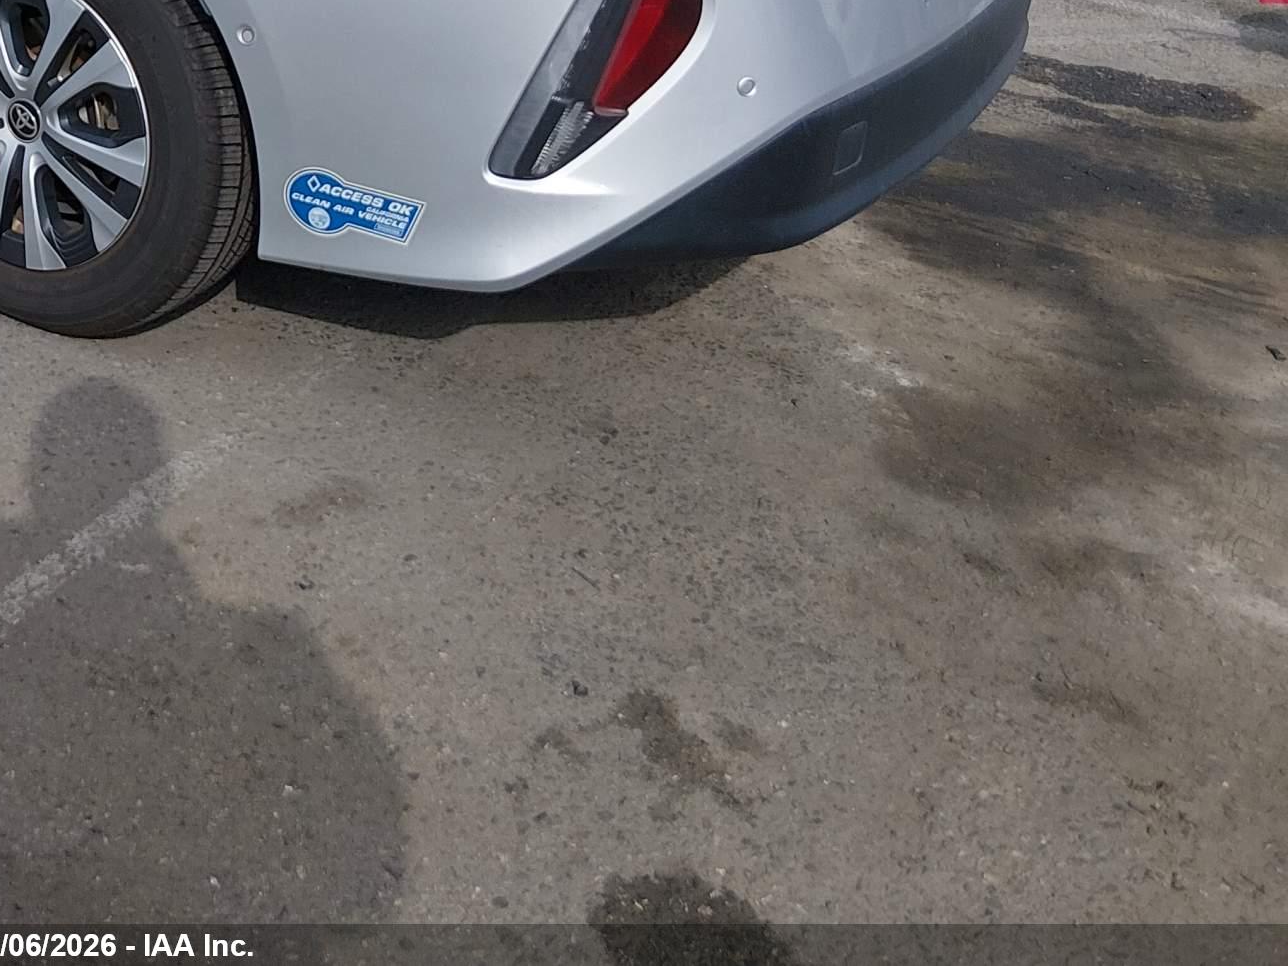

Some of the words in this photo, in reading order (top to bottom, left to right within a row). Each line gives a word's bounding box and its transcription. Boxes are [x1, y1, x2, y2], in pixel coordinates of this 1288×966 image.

[291, 192, 331, 209] CLEAN
[332, 204, 355, 216] AIR
[358, 210, 408, 229] VEHICLE
[318, 184, 384, 208] ACCESS
[387, 201, 415, 216] OK
